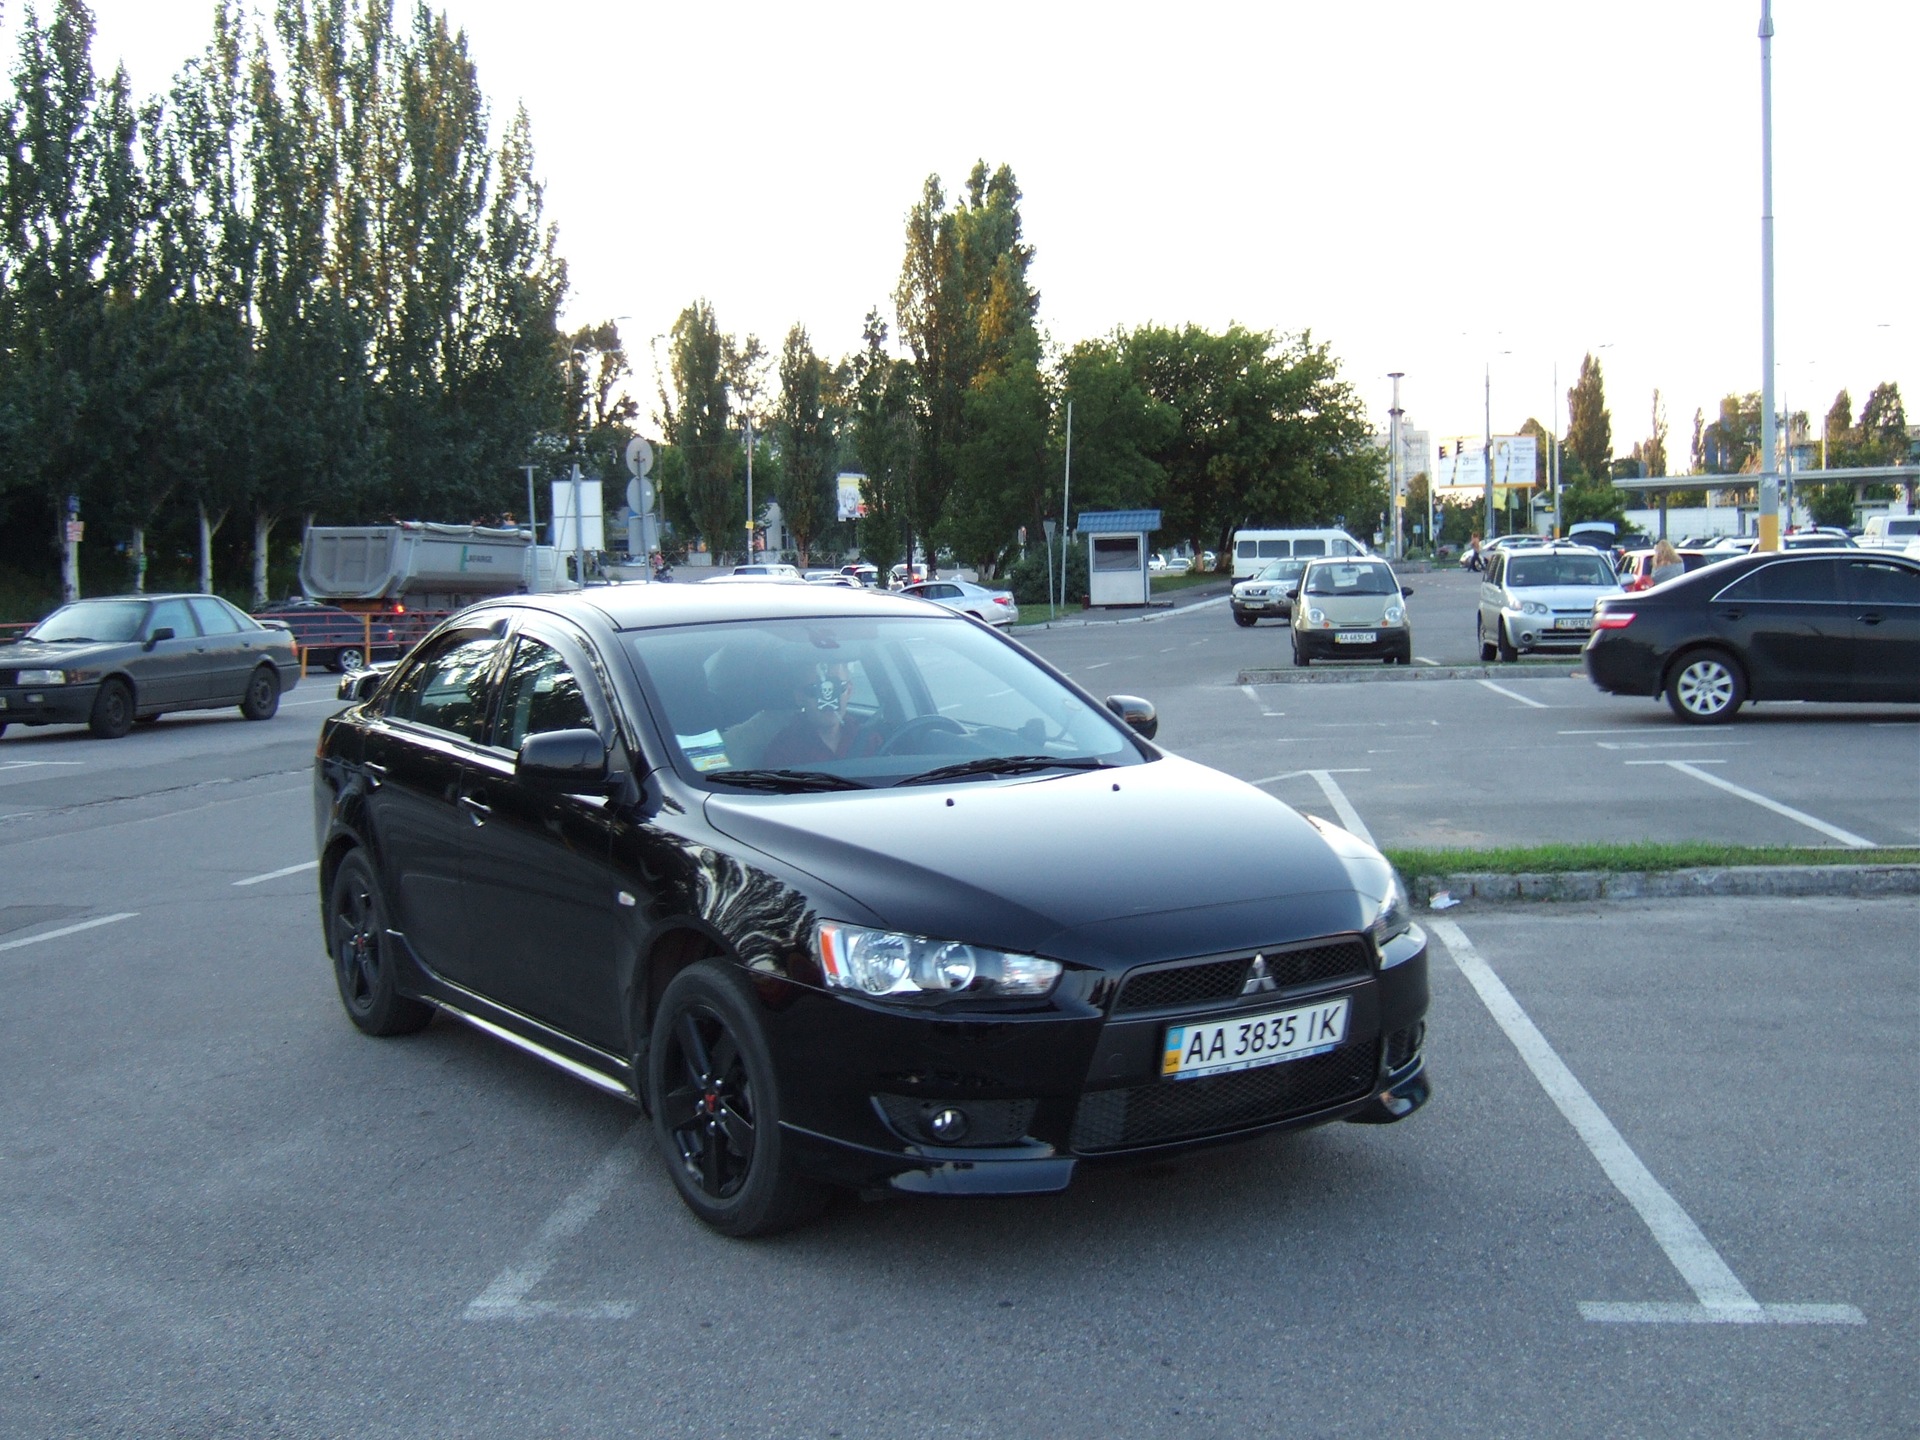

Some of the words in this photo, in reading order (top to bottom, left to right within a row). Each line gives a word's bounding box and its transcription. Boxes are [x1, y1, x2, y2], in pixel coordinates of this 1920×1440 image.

[1184, 1028, 1226, 1064] AA
[1234, 1015, 1299, 1056] 3835
[1306, 1005, 1342, 1043] IK
